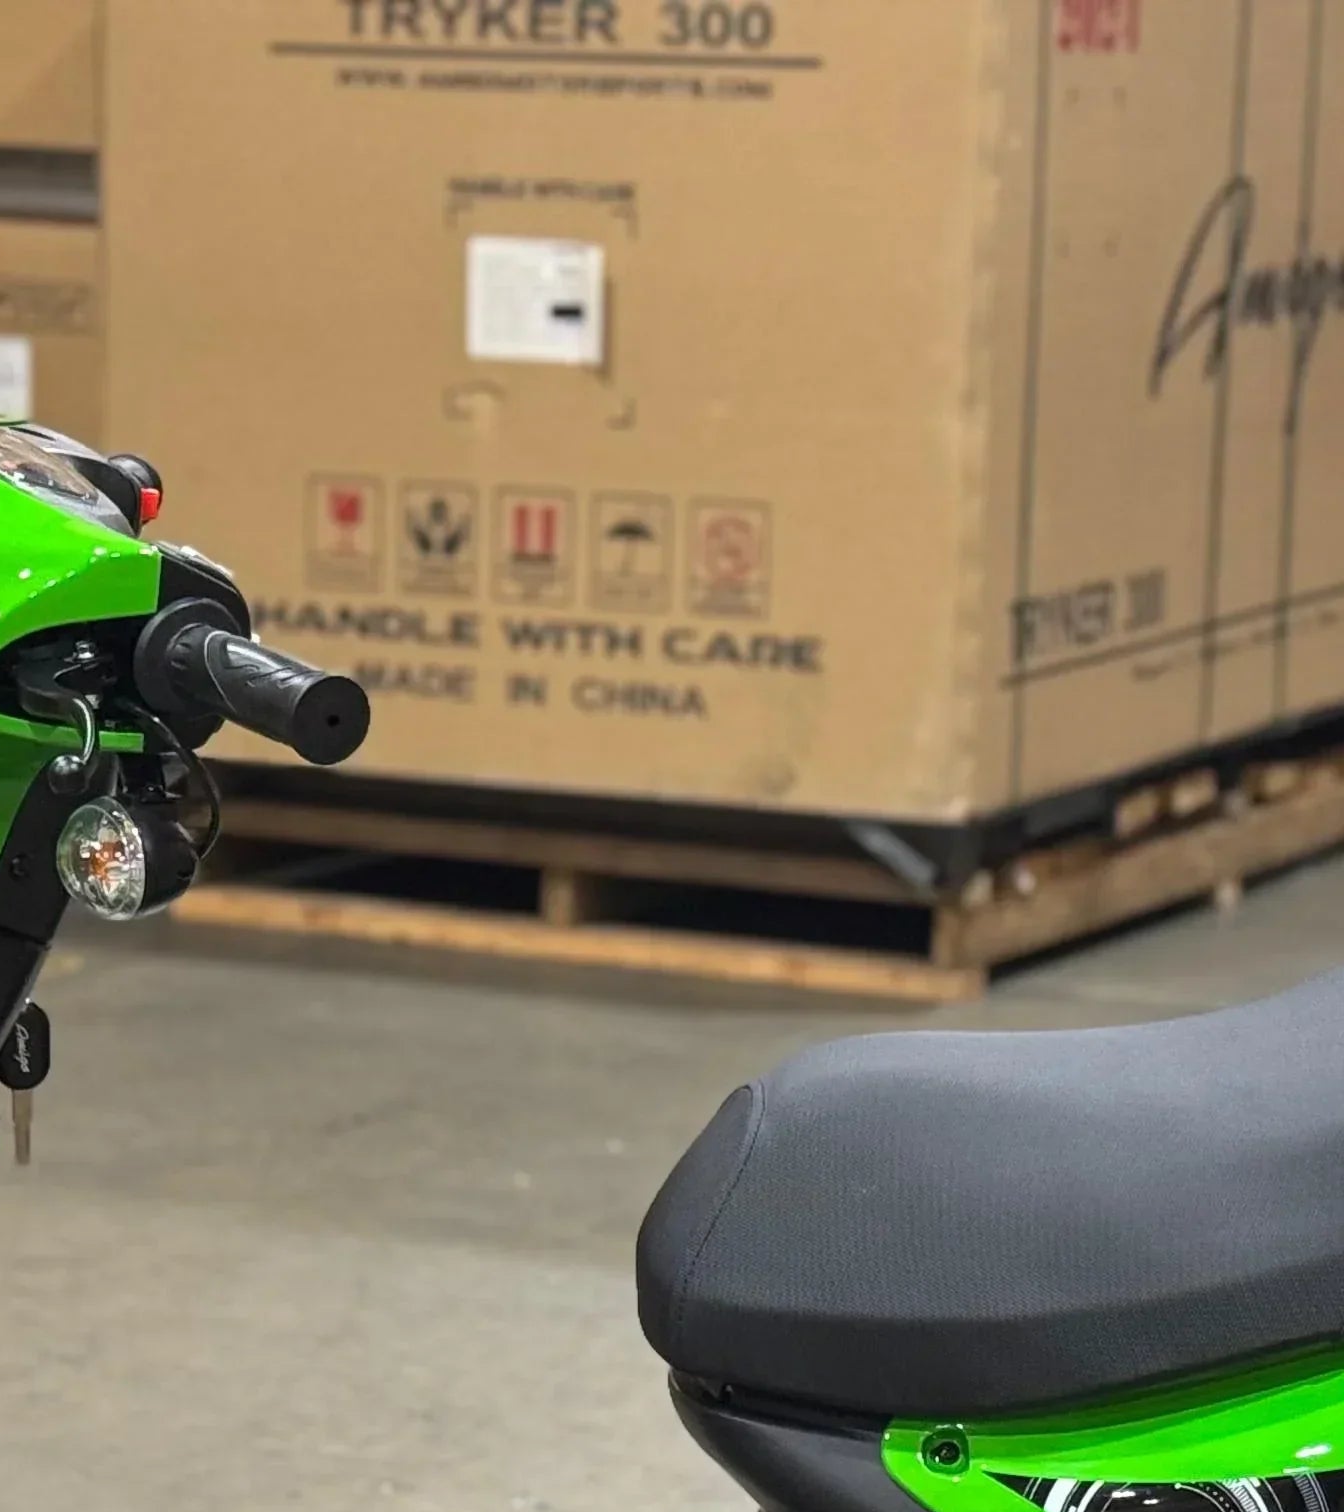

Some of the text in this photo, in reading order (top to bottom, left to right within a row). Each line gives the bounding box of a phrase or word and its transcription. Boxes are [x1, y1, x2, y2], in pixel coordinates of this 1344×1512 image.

[659, 0, 775, 48] 300
[253, 599, 825, 674] HANDLE WITH CARE
[352, 659, 708, 719] MADE IN CHINA
